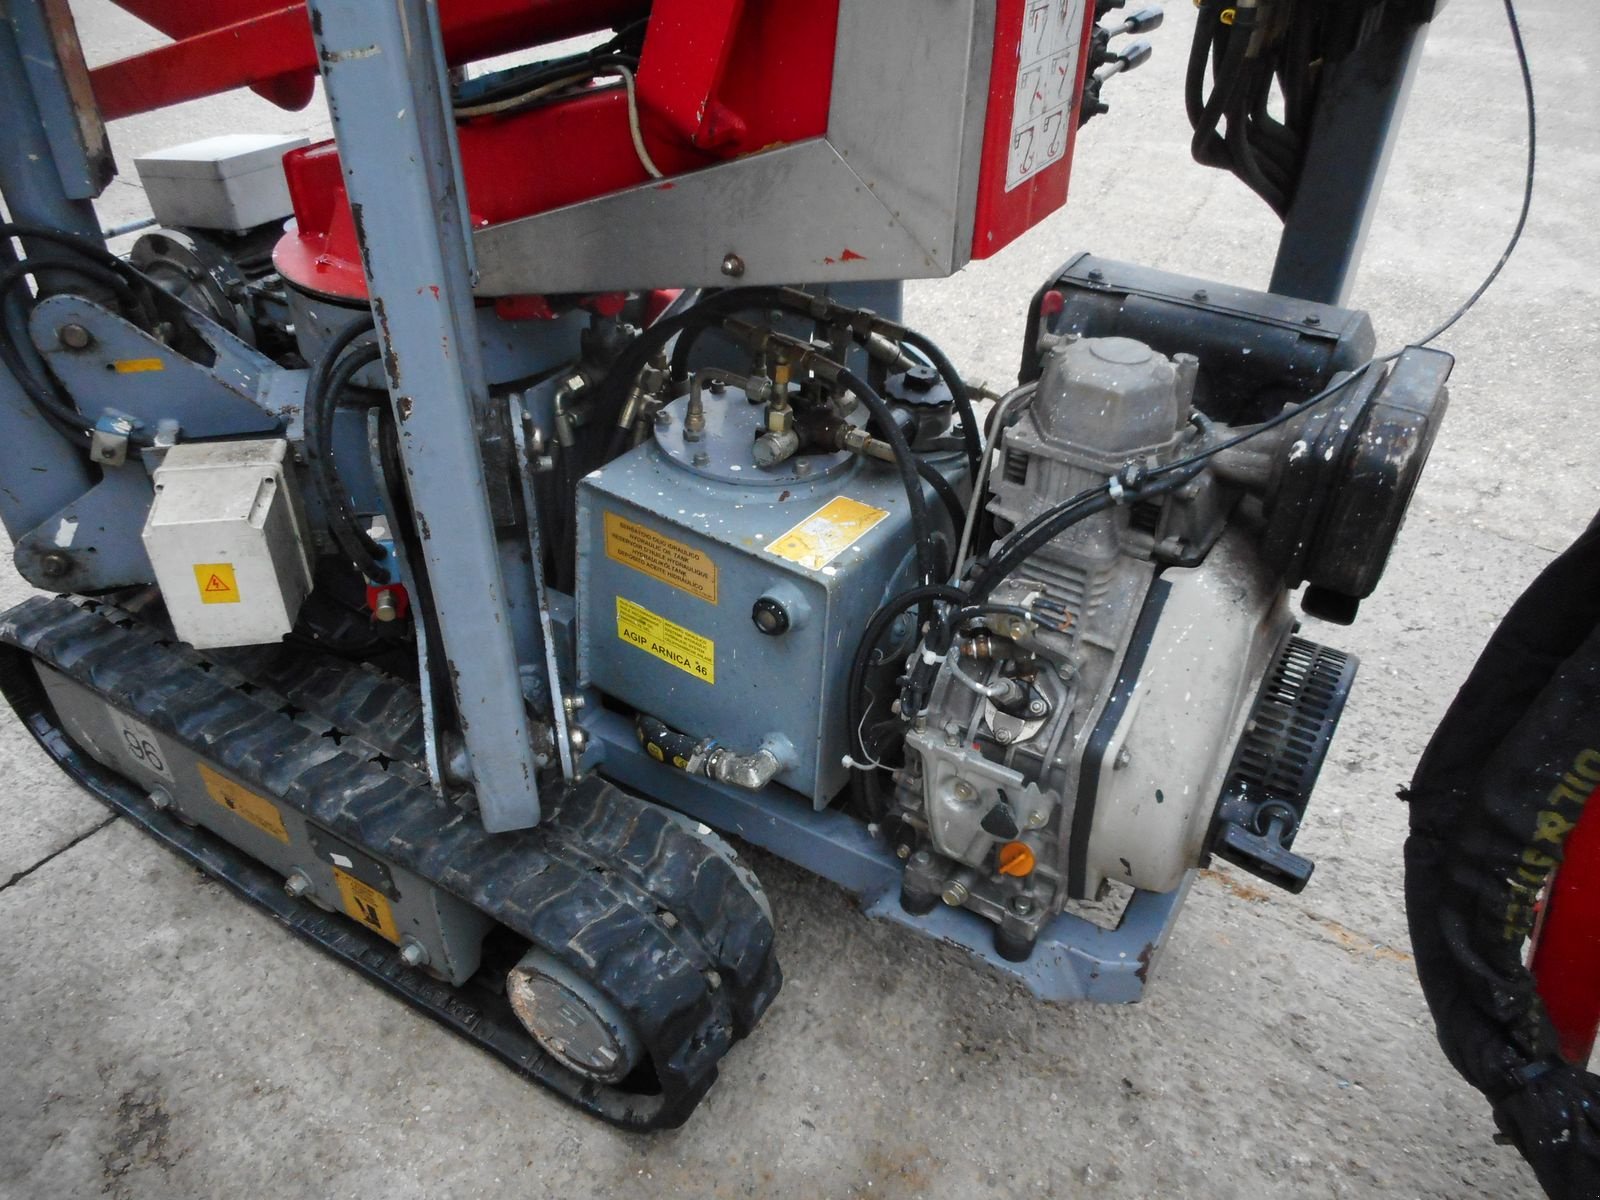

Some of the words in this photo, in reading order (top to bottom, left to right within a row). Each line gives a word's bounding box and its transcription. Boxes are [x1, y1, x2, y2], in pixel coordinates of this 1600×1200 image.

[612, 533, 642, 550] RESERVOIR
[667, 557, 708, 578] HYDRAULIQUE
[630, 534, 661, 551] HYDRAULIC
[674, 553, 689, 563] TANK
[668, 543, 699, 560] IDRAULICO
[646, 562, 665, 574] ACEITE
[623, 628, 647, 645] AGIP
[651, 642, 692, 669] ARNICA
[695, 664, 707, 676] 46
[124, 729, 163, 771] 96
